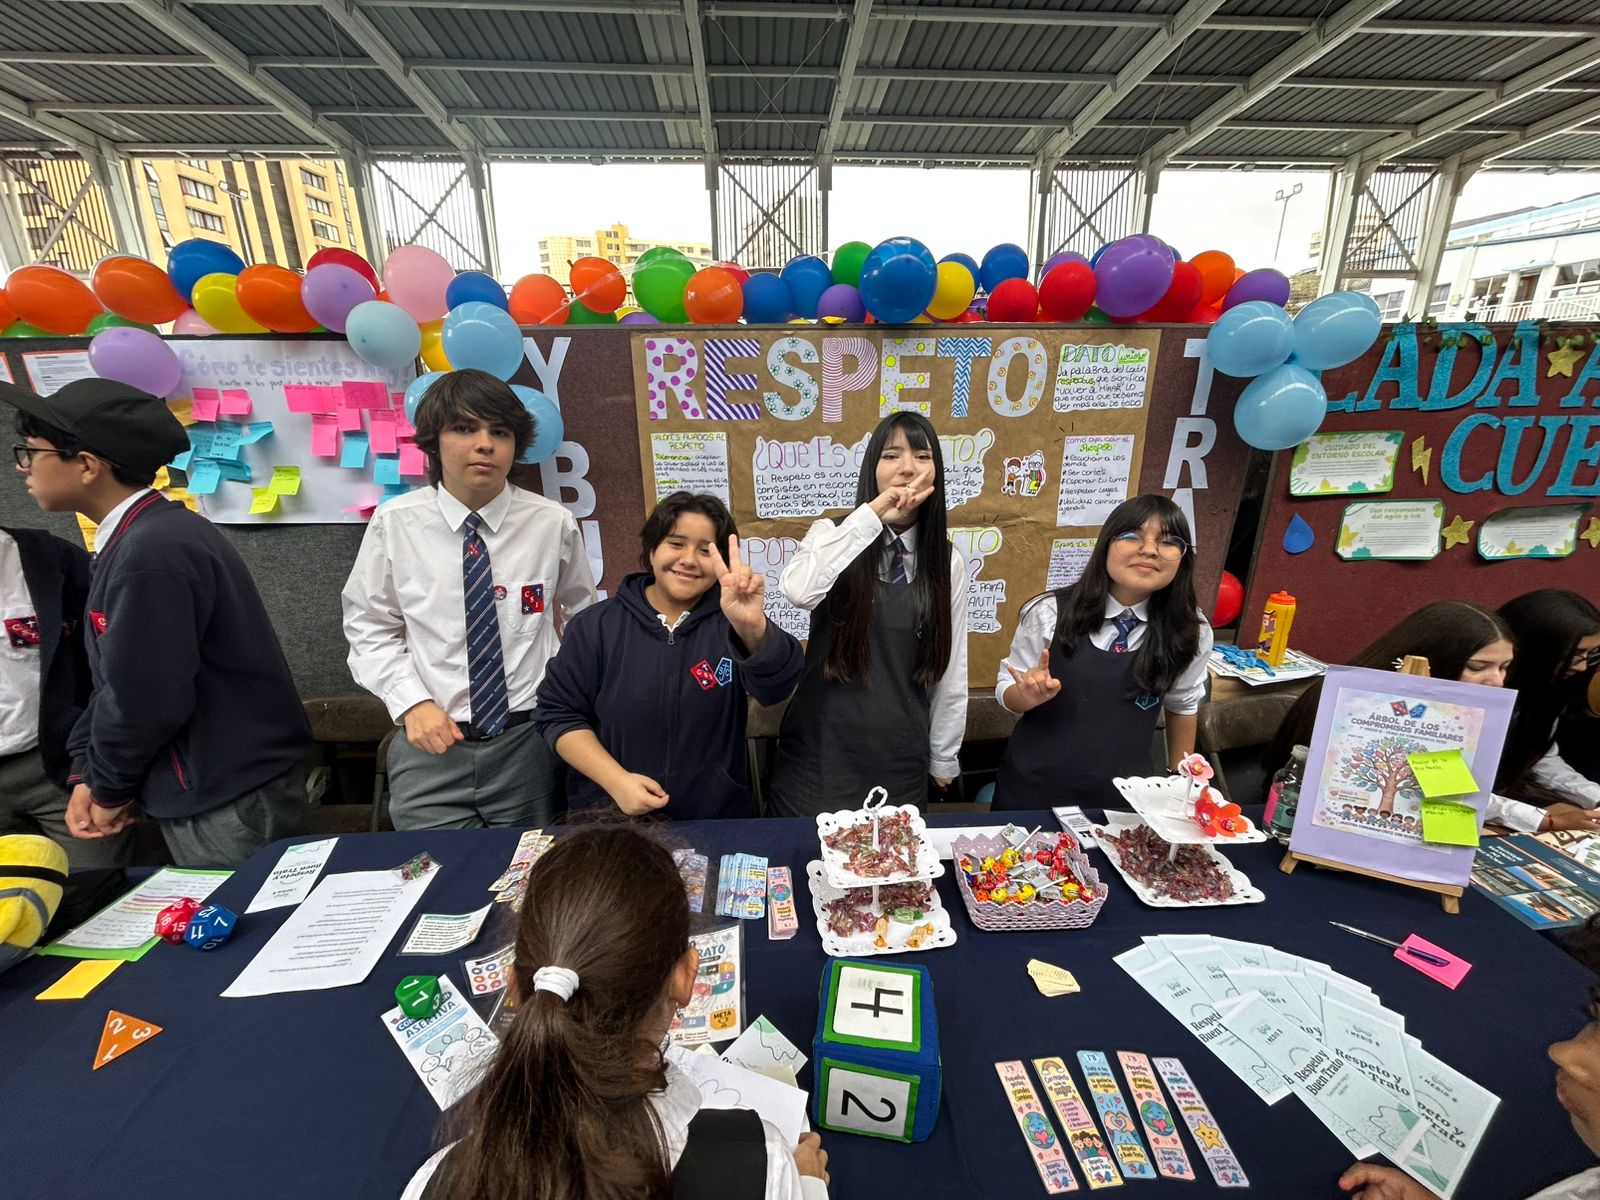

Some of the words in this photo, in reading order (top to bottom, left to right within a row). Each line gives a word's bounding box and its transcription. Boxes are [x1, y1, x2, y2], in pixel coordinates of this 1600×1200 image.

[1062, 345, 1116, 362] DATO
[523, 337, 571, 412] Y
[645, 337, 1047, 422] RESPETO
[669, 442, 705, 450] RESPETO
[1311, 450, 1350, 460] ENTORNO
[1351, 450, 1386, 458] ESCOLAR
[1324, 443, 1360, 452] CUIDADO
[1362, 442, 1377, 450] DEL
[771, 473, 811, 483] Respeto
[962, 465, 982, 479] que
[756, 485, 801, 494] consiste
[759, 500, 799, 509] rencias
[1351, 717, 1412, 733] COMPROMISOS
[1414, 728, 1464, 743] FAMILIARES
[1368, 711, 1400, 725] ÁRBOL
[1403, 719, 1417, 727] DE
[1421, 721, 1440, 731] LOS
[171, 921, 187, 932] 15
[190, 925, 205, 940] 11
[403, 978, 420, 989] 1
[850, 987, 904, 1019] 4
[713, 1010, 732, 1020] META
[108, 1017, 128, 1036] 2
[131, 1026, 152, 1040] 3
[102, 1043, 119, 1062] 1
[1294, 1053, 1324, 1082] Respeto
[1335, 1048, 1391, 1078] Respeto
[1305, 1074, 1328, 1097] Buen
[1320, 1057, 1344, 1081] Trato
[1366, 1072, 1410, 1096] Trato
[840, 1089, 897, 1123] 2
